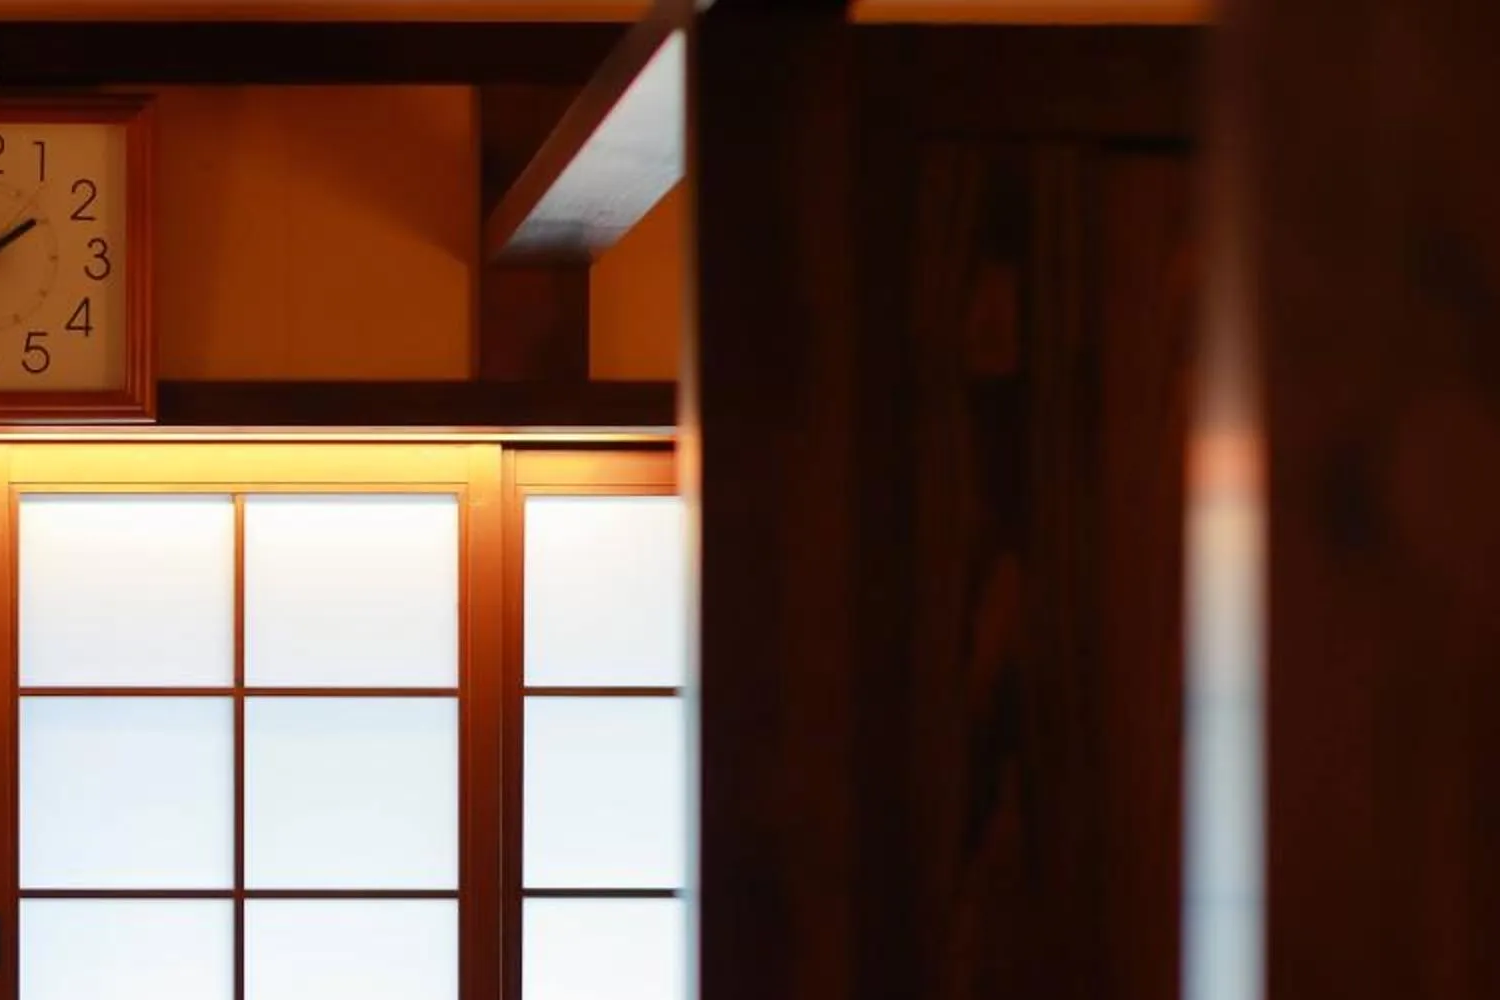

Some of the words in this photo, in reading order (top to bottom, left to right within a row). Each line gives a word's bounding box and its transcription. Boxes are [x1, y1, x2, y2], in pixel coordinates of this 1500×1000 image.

[32, 140, 45, 182] 1
[70, 178, 97, 222] 2
[84, 237, 112, 281] 3
[64, 296, 94, 337] 4
[21, 331, 50, 375] 5
